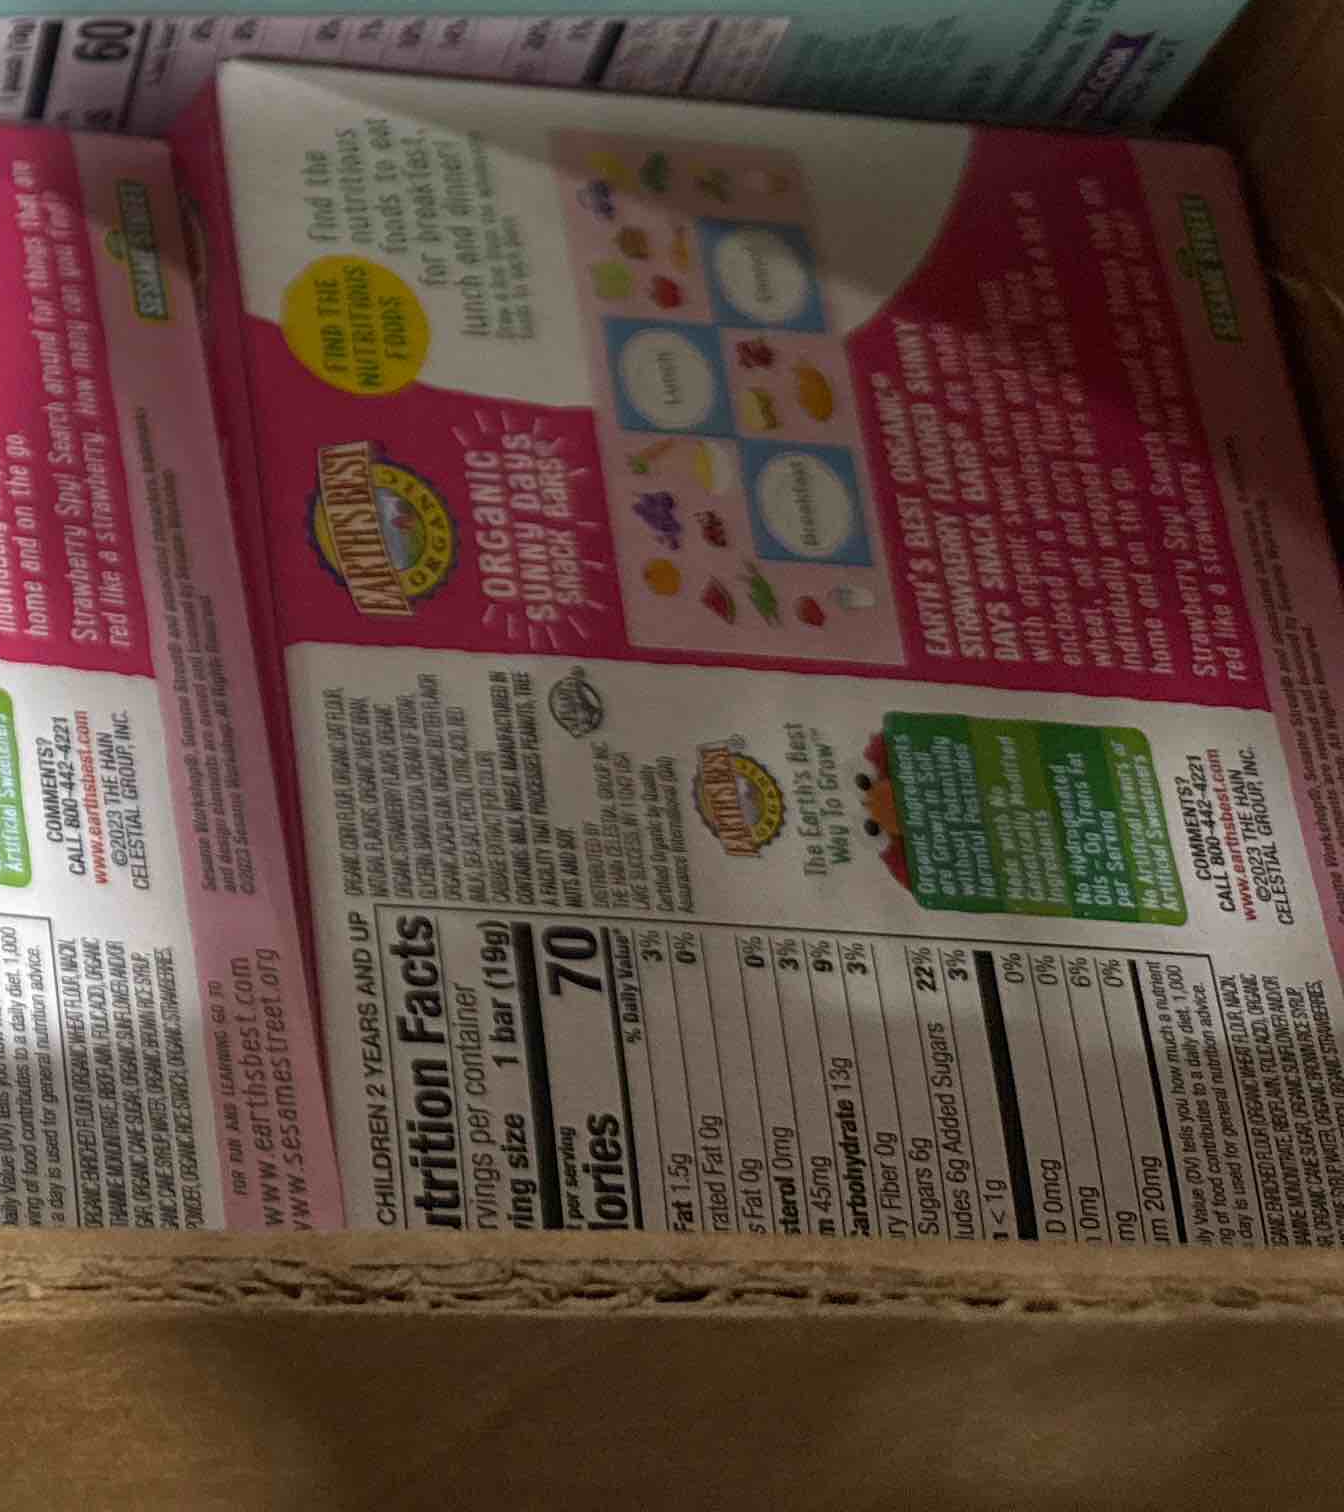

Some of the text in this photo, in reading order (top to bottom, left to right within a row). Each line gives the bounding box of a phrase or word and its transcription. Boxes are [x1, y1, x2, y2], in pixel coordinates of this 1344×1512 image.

[72, 19, 134, 62] 60
[34, 737, 67, 844] COMMENTS?
[50, 714, 89, 876] CALL 800-442-4221
[72, 709, 111, 885] www.earthsbest.com
[1173, 775, 1213, 881] COMMENTS?
[1184, 754, 1237, 913] CALL 800-442-4221
[1202, 747, 1259, 922] www.earthsbest.com
[387, 914, 445, 1045] Facts
[539, 923, 604, 998] 70
